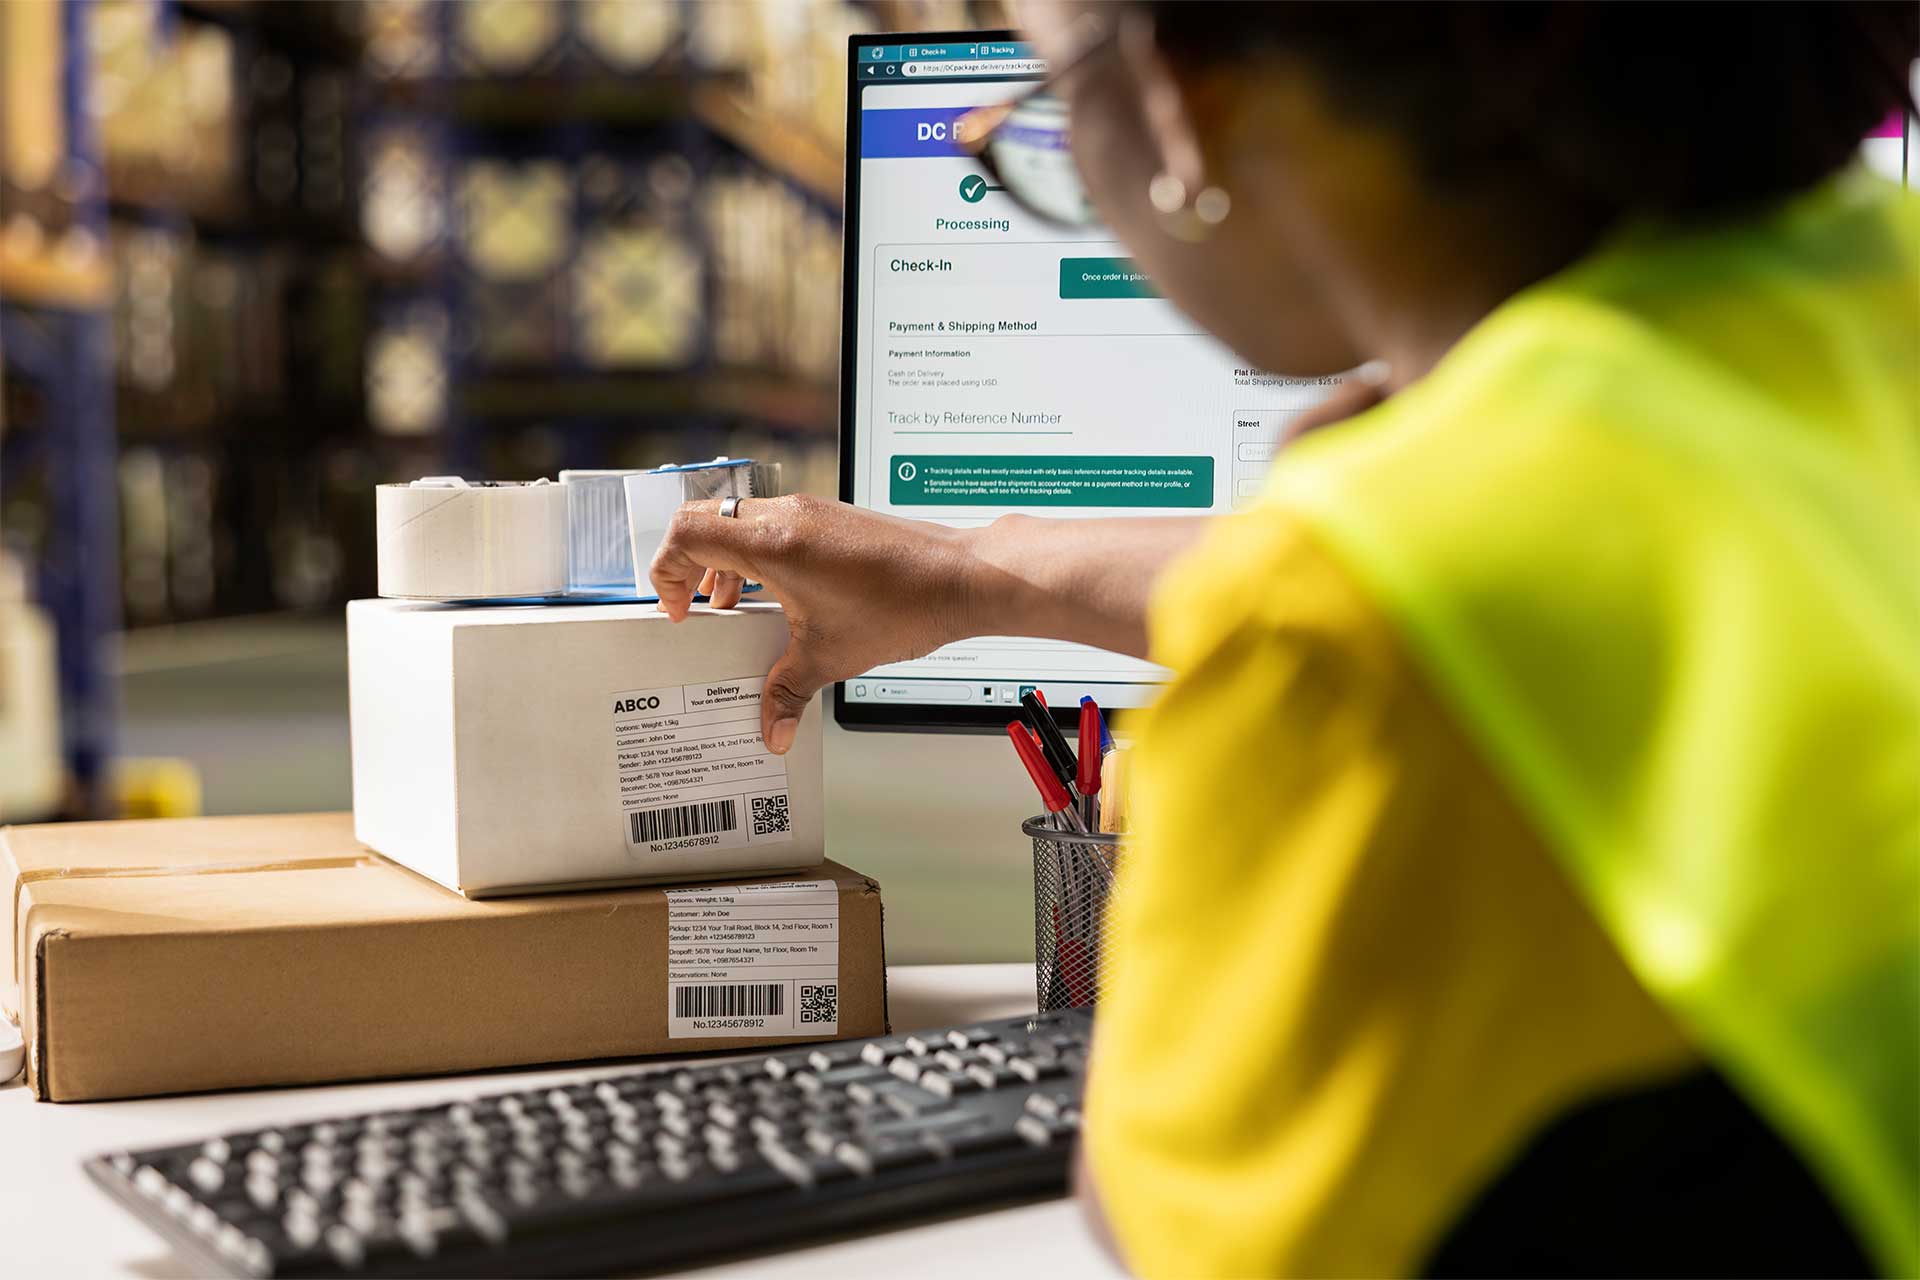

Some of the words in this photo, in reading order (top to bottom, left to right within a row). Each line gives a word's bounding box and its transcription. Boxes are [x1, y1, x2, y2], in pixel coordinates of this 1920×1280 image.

[991, 47, 1015, 55] Tracking
[918, 122, 946, 140] DC
[936, 218, 1010, 232] Processing
[890, 259, 952, 272] Check-In
[1082, 272, 1101, 281] Once
[1102, 273, 1121, 281] order
[889, 321, 934, 334] Payment
[937, 321, 945, 331] &
[948, 320, 995, 333] Shipping
[998, 320, 1038, 331] Method
[888, 350, 923, 359] Payment
[917, 370, 944, 378] Delivery
[936, 379, 960, 387] placed
[961, 379, 980, 387] using
[1251, 378, 1283, 387] Shipping
[887, 412, 921, 424] Track
[924, 412, 940, 427] by
[943, 411, 1008, 424] Reference
[1011, 412, 1063, 424] Number
[991, 468, 1009, 476] mostly
[1096, 481, 1120, 489] payment
[1163, 481, 1183, 489] profile,
[1029, 488, 1051, 496] tracking
[707, 686, 740, 697] Delivery
[714, 695, 737, 703] demand
[738, 692, 761, 700] delivery
[614, 696, 660, 714] ABCO
[615, 724, 640, 733] Options:
[641, 721, 663, 729] Weight:
[664, 719, 679, 727] 1.5kg
[616, 738, 647, 746] Customer:
[700, 742, 716, 750] Block
[618, 761, 641, 769] Sender:
[658, 753, 702, 763] +123456789123
[620, 775, 644, 783] Dropoff:
[691, 766, 710, 774] Name,
[720, 762, 737, 770] Floor,
[621, 784, 648, 792] Receiver:
[664, 776, 703, 786] +0987654321
[622, 796, 661, 806] Observations:
[650, 835, 720, 852] No.12345678912
[693, 1019, 764, 1029] No.12345678912
